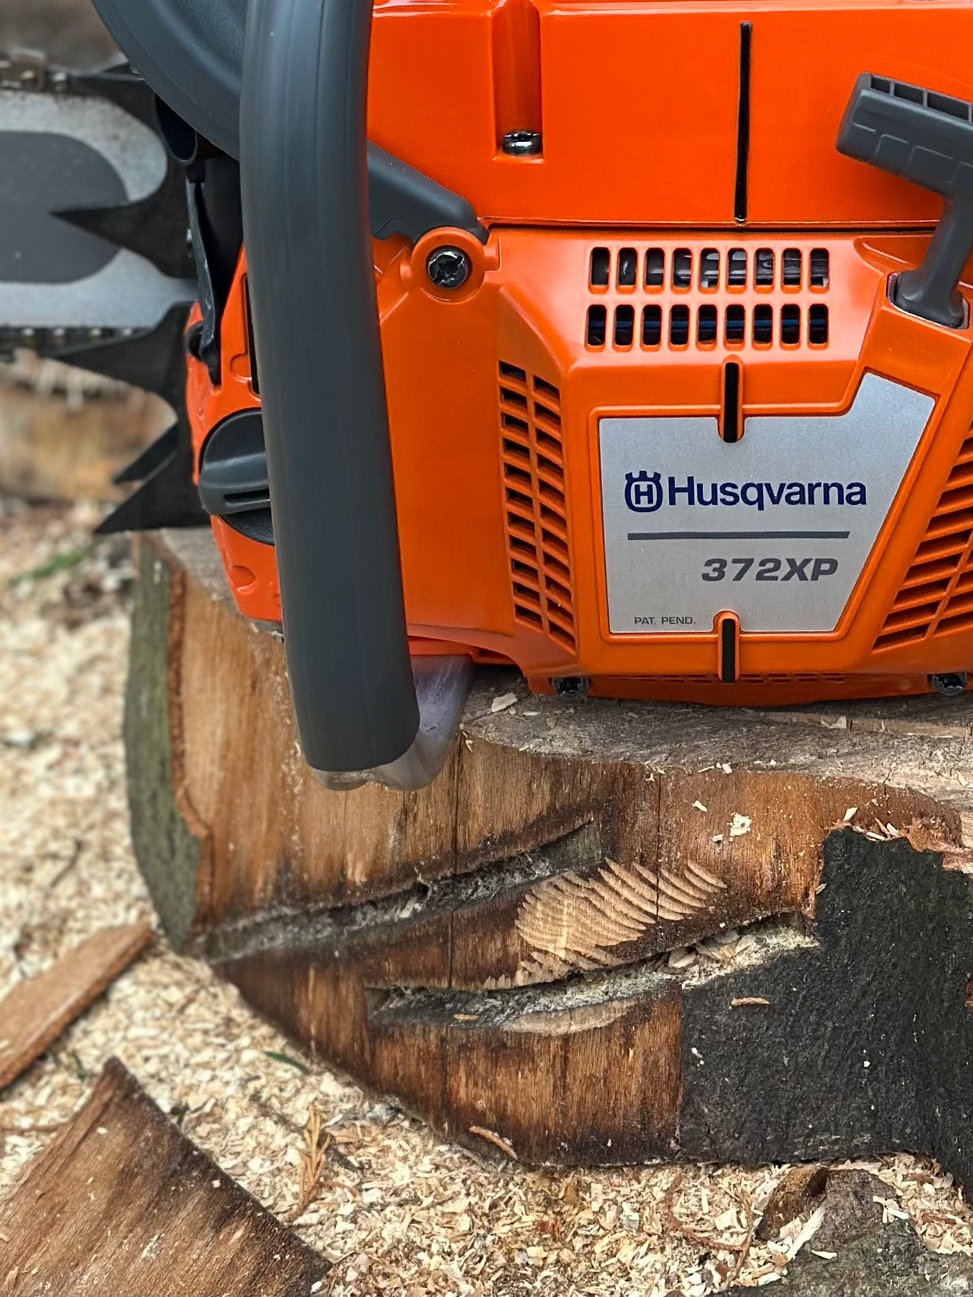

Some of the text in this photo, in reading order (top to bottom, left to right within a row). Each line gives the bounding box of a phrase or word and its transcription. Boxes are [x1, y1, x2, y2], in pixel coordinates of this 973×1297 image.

[668, 476, 867, 511] Husqvarna
[701, 558, 839, 582] 372XP
[634, 616, 697, 626] PAT. PEND.
